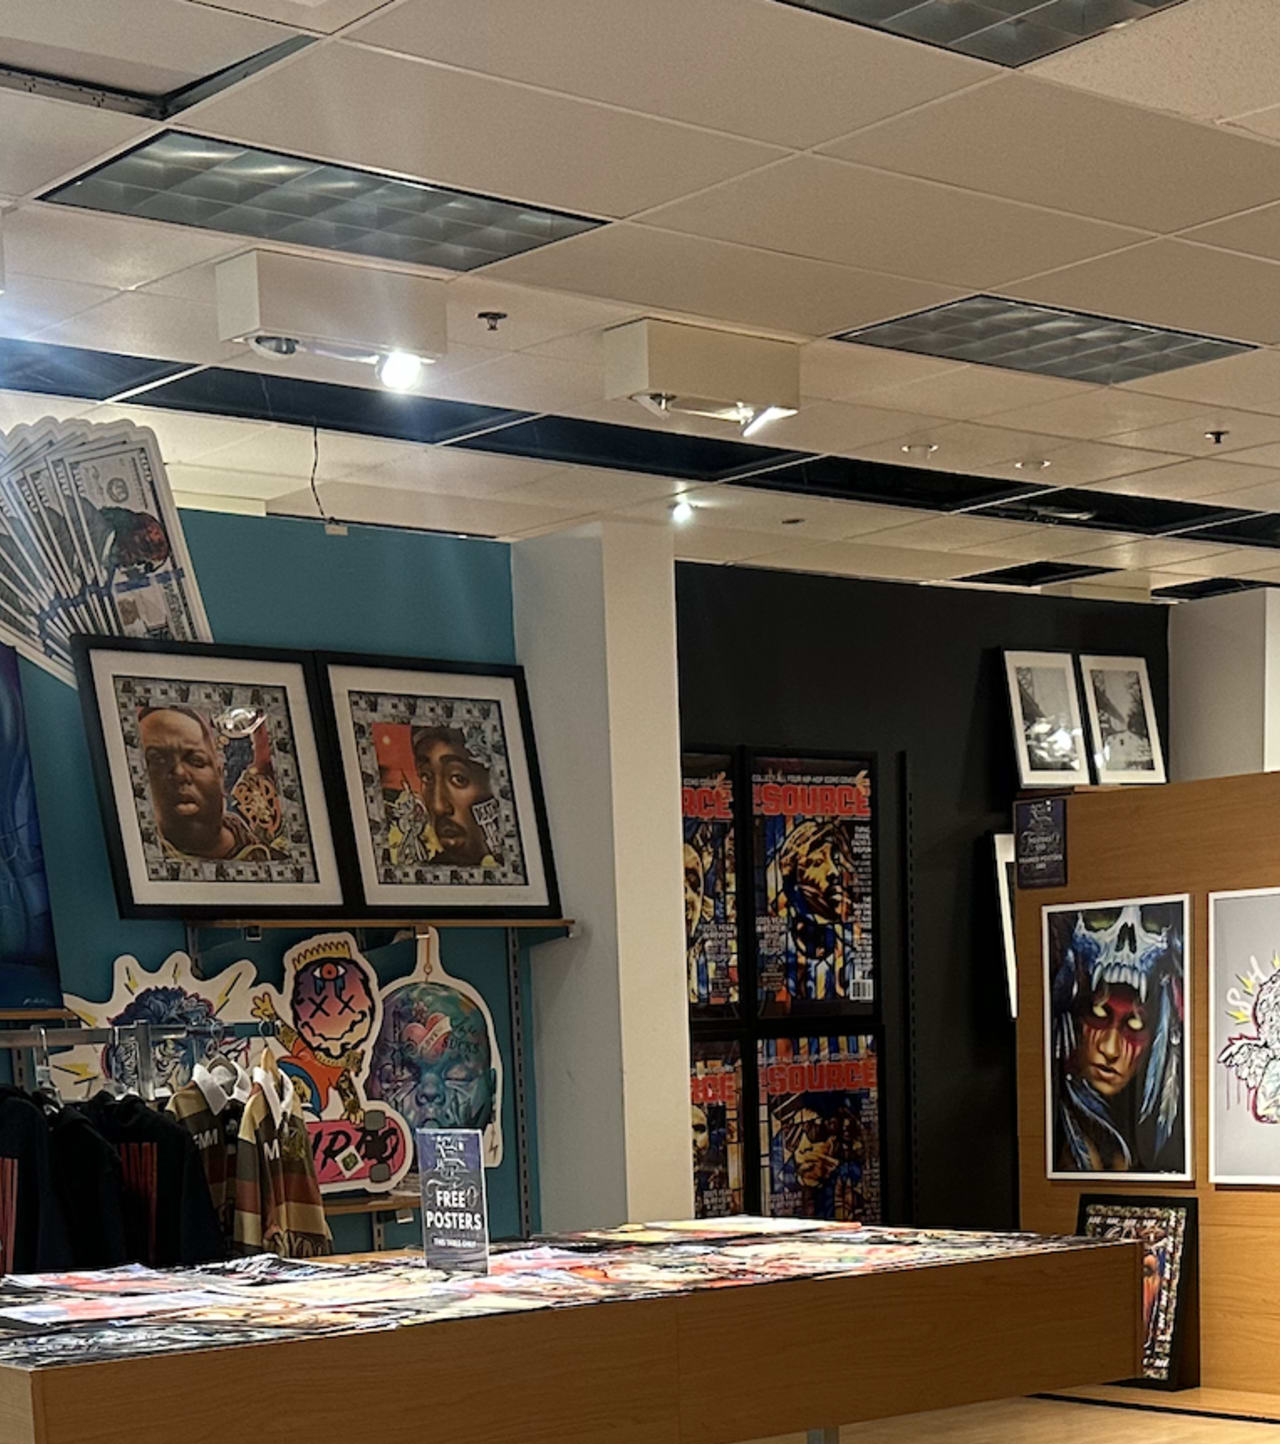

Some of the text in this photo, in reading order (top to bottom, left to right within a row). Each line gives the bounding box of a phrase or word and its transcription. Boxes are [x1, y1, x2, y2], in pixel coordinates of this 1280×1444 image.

[762, 783, 871, 817] SOURCE
[767, 1059, 878, 1095] SOURCE
[436, 1188, 467, 1209] FREE
[426, 1211, 482, 1230] POSTERS
